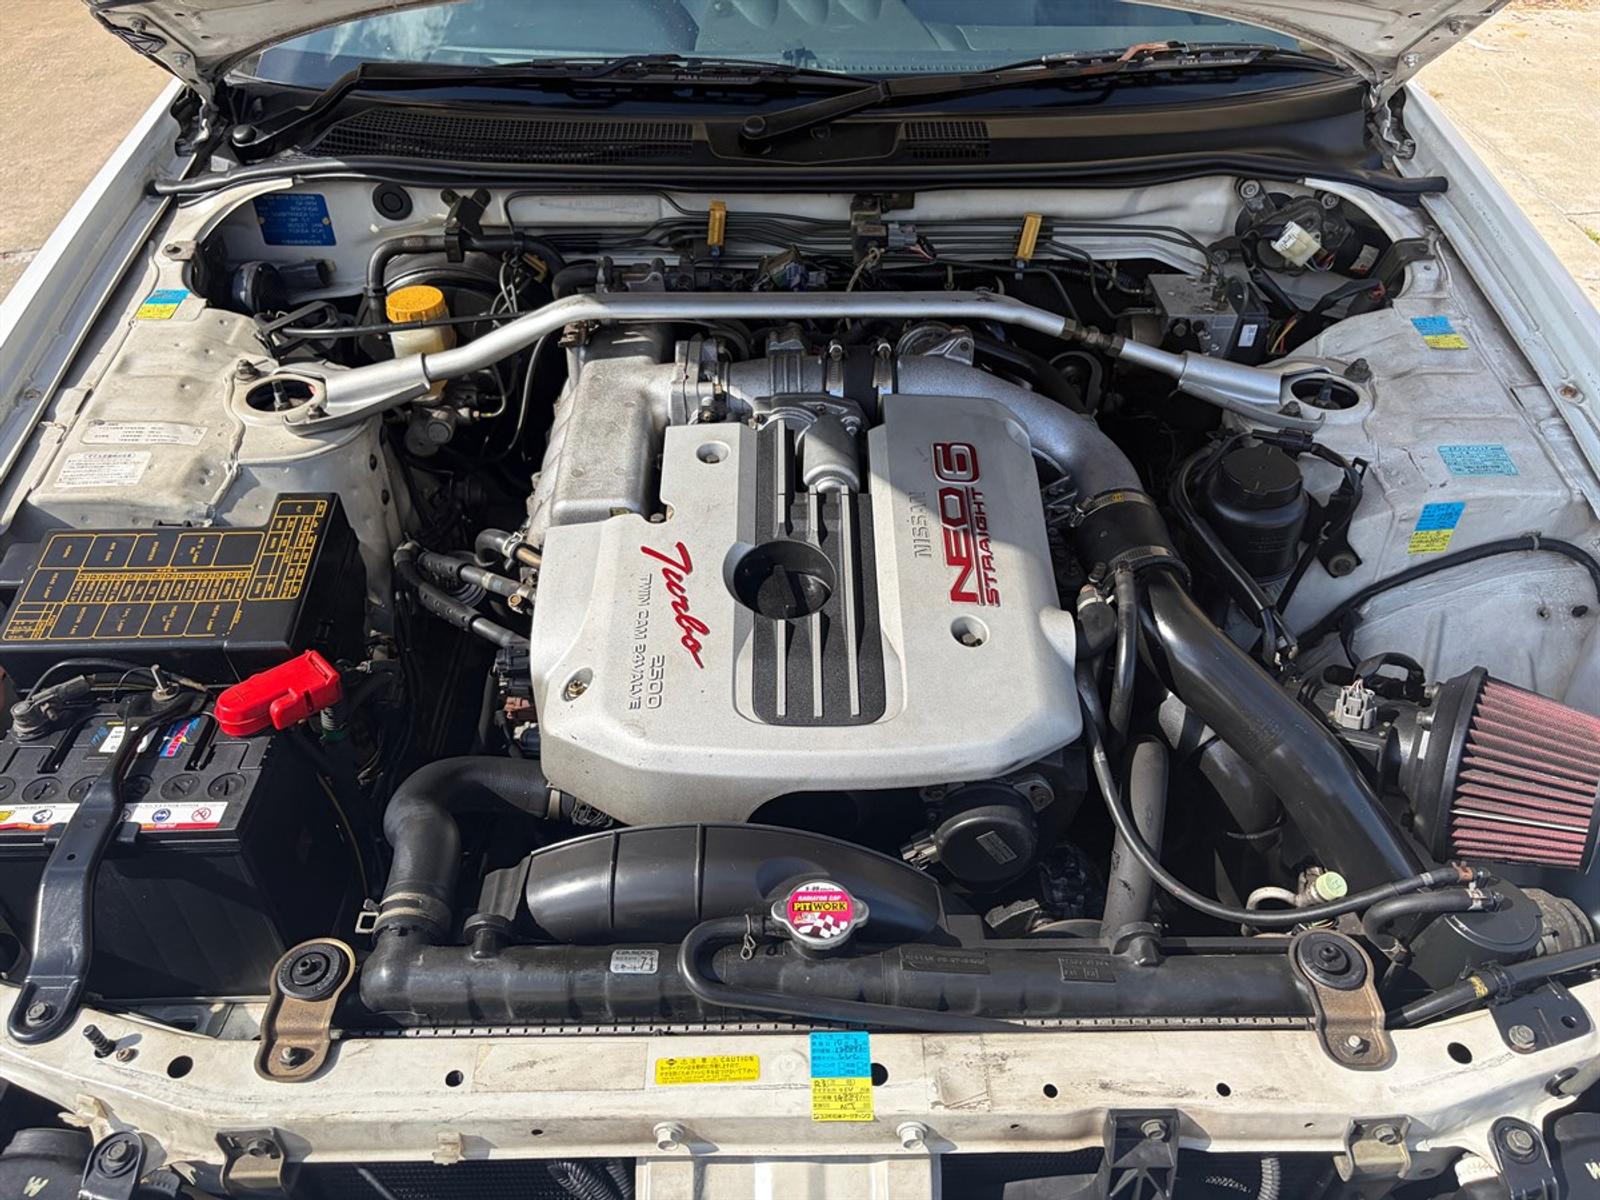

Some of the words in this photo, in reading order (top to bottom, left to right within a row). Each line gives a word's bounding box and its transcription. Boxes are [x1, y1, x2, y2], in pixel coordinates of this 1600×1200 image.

[932, 442, 981, 485] 6
[907, 490, 932, 559] NISSAN
[938, 486, 979, 603] NEO
[972, 491, 1001, 608] STRAIGHT
[639, 573, 653, 607] TWIN
[640, 541, 711, 670] Turbo
[634, 610, 649, 640] CAM
[648, 655, 665, 710] 2500
[793, 901, 848, 911] PITWORK
[720, 1055, 754, 1063] CAUTION
